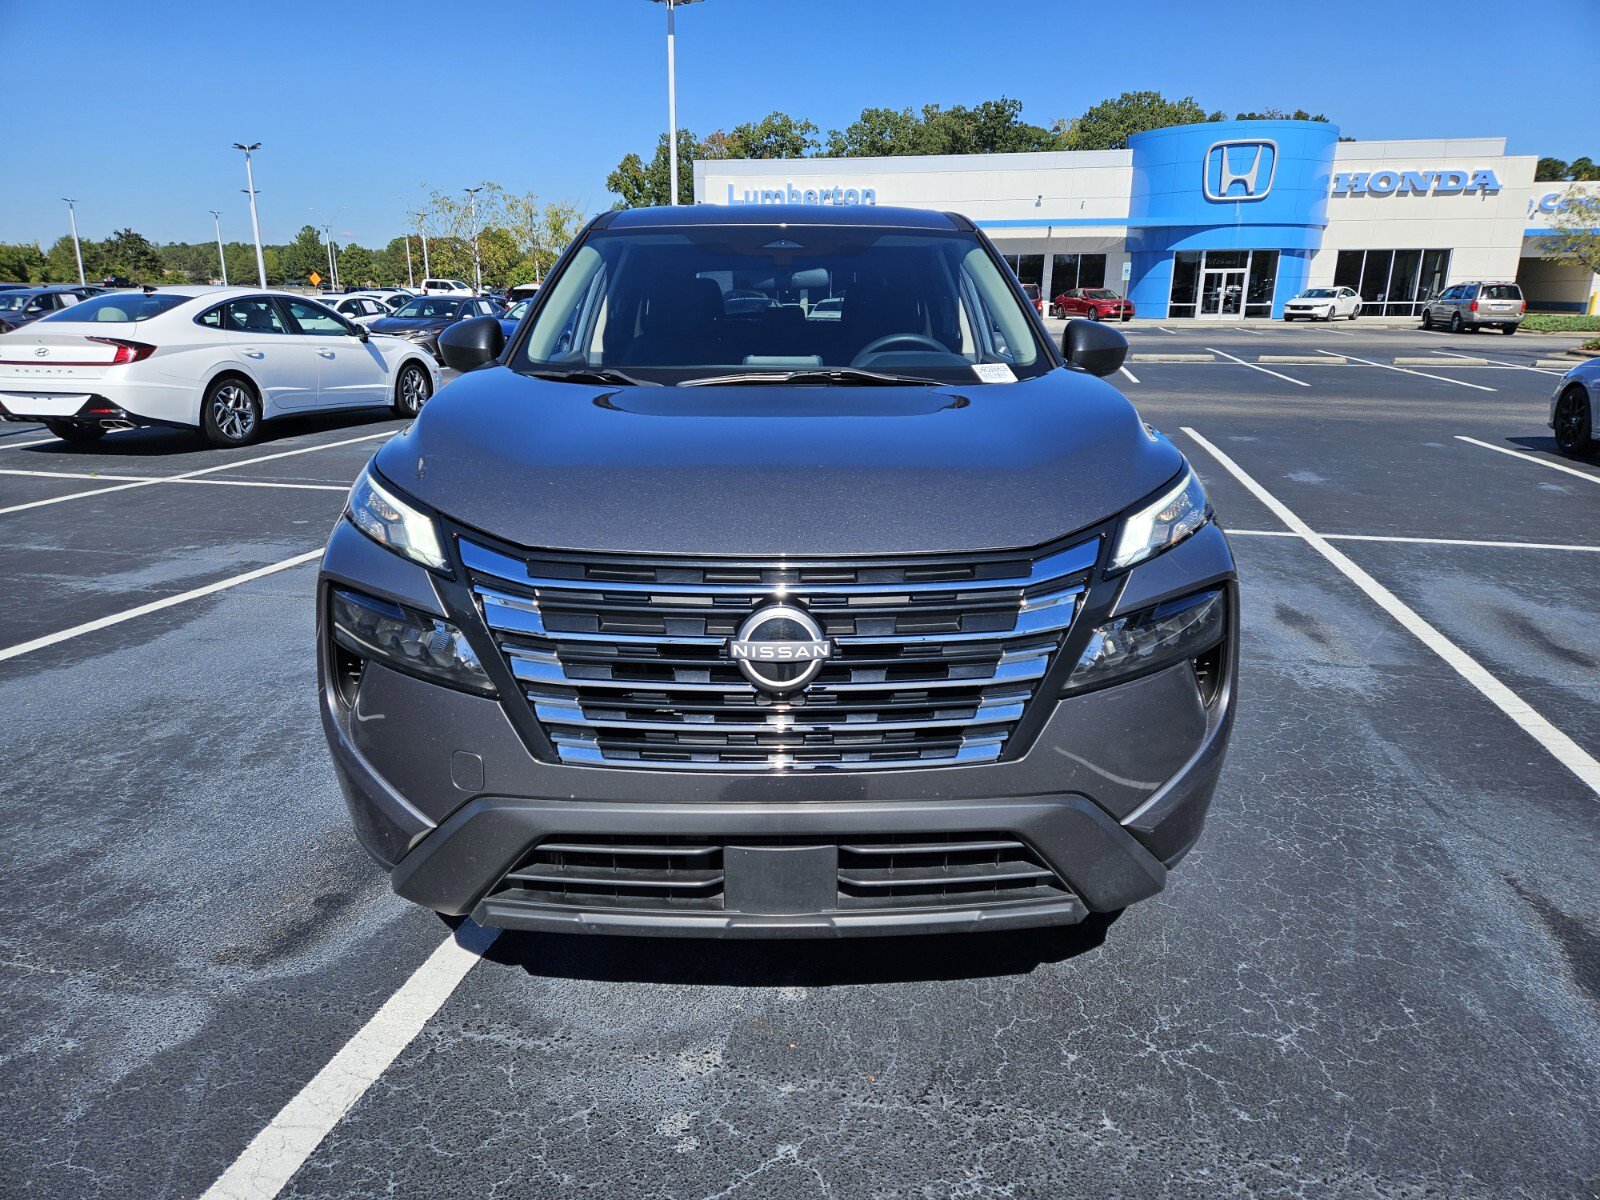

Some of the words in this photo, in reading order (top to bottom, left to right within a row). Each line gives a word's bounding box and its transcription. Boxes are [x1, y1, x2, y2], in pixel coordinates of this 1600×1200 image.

[1333, 168, 1503, 197] HONDA
[727, 183, 877, 206] Lumberton
[733, 644, 829, 658] NISSAN
